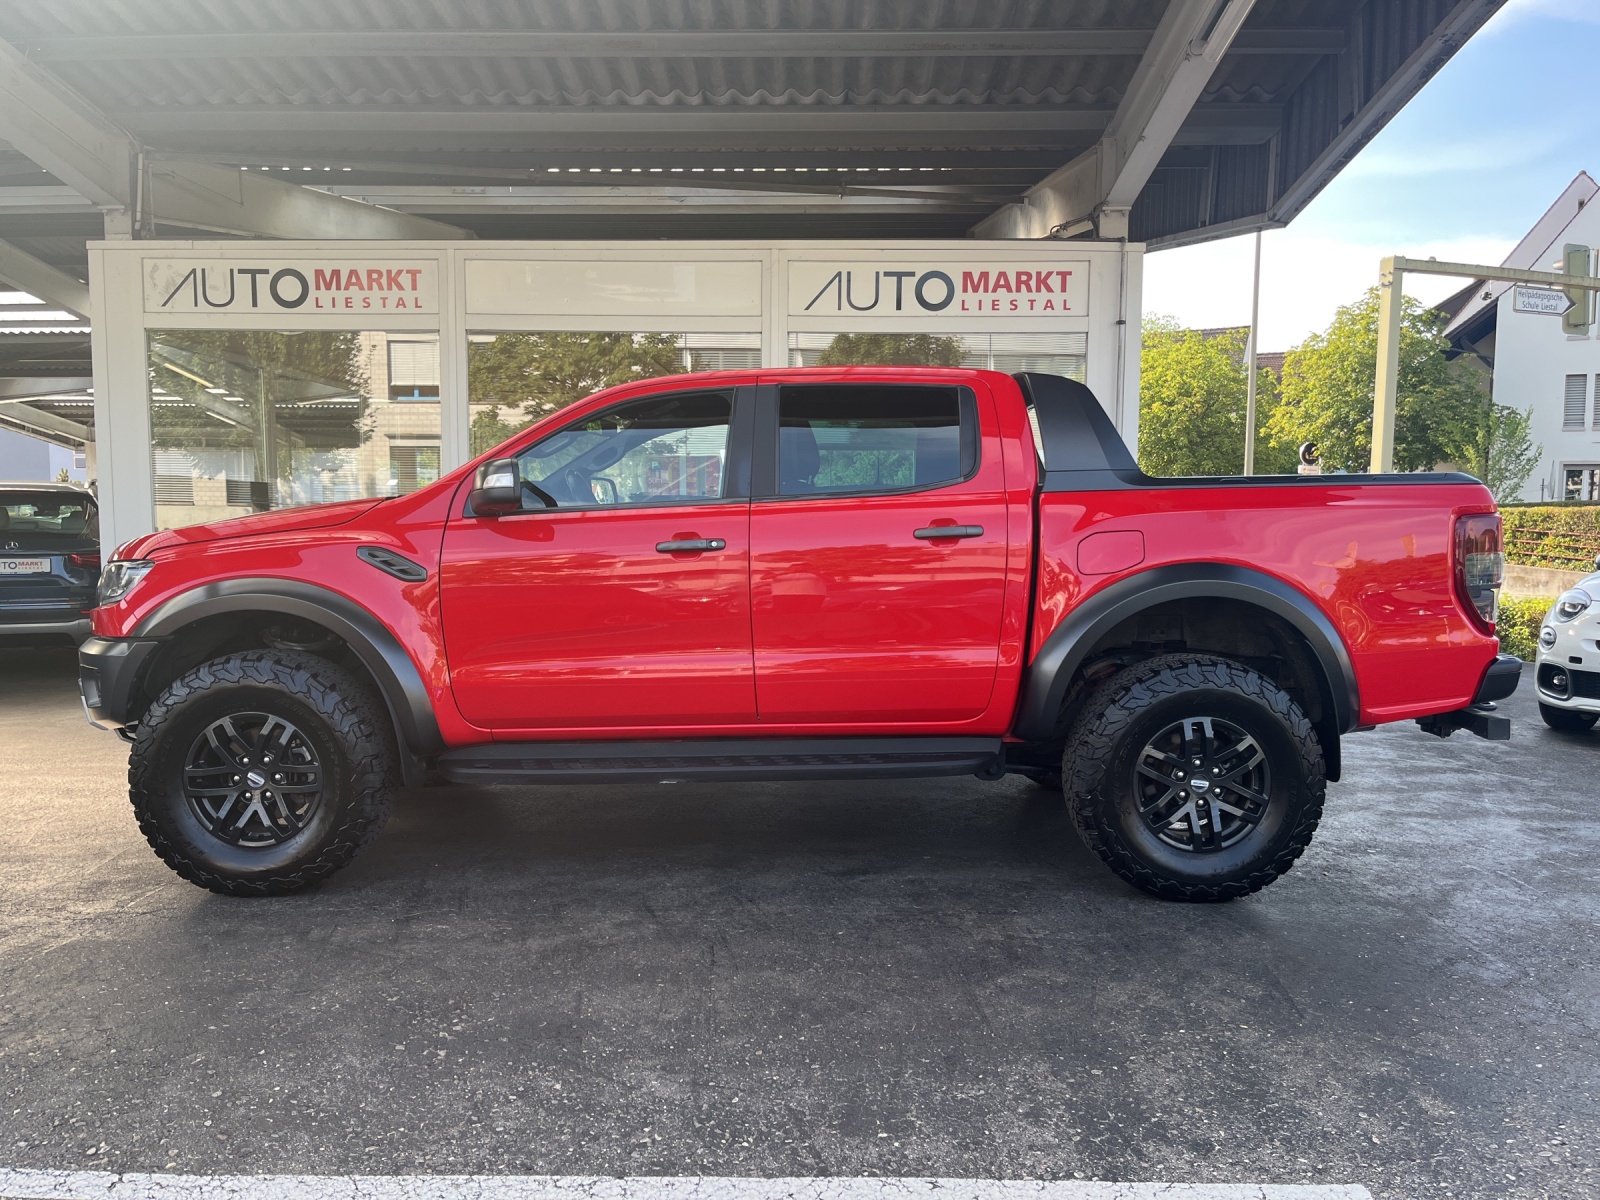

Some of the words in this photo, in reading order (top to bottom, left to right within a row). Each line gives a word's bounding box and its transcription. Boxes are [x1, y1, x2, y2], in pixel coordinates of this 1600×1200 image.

[162, 268, 309, 309] AUTO
[314, 269, 422, 291] MARKT
[804, 270, 955, 311] AUTO
[962, 271, 1072, 293] MARKT
[1517, 289, 1563, 302] Heilpädagogische
[315, 296, 423, 309] LIESTAL
[961, 299, 1072, 311] LIESTAL
[1522, 300, 1539, 310] Schule
[1541, 302, 1558, 311] Liestal
